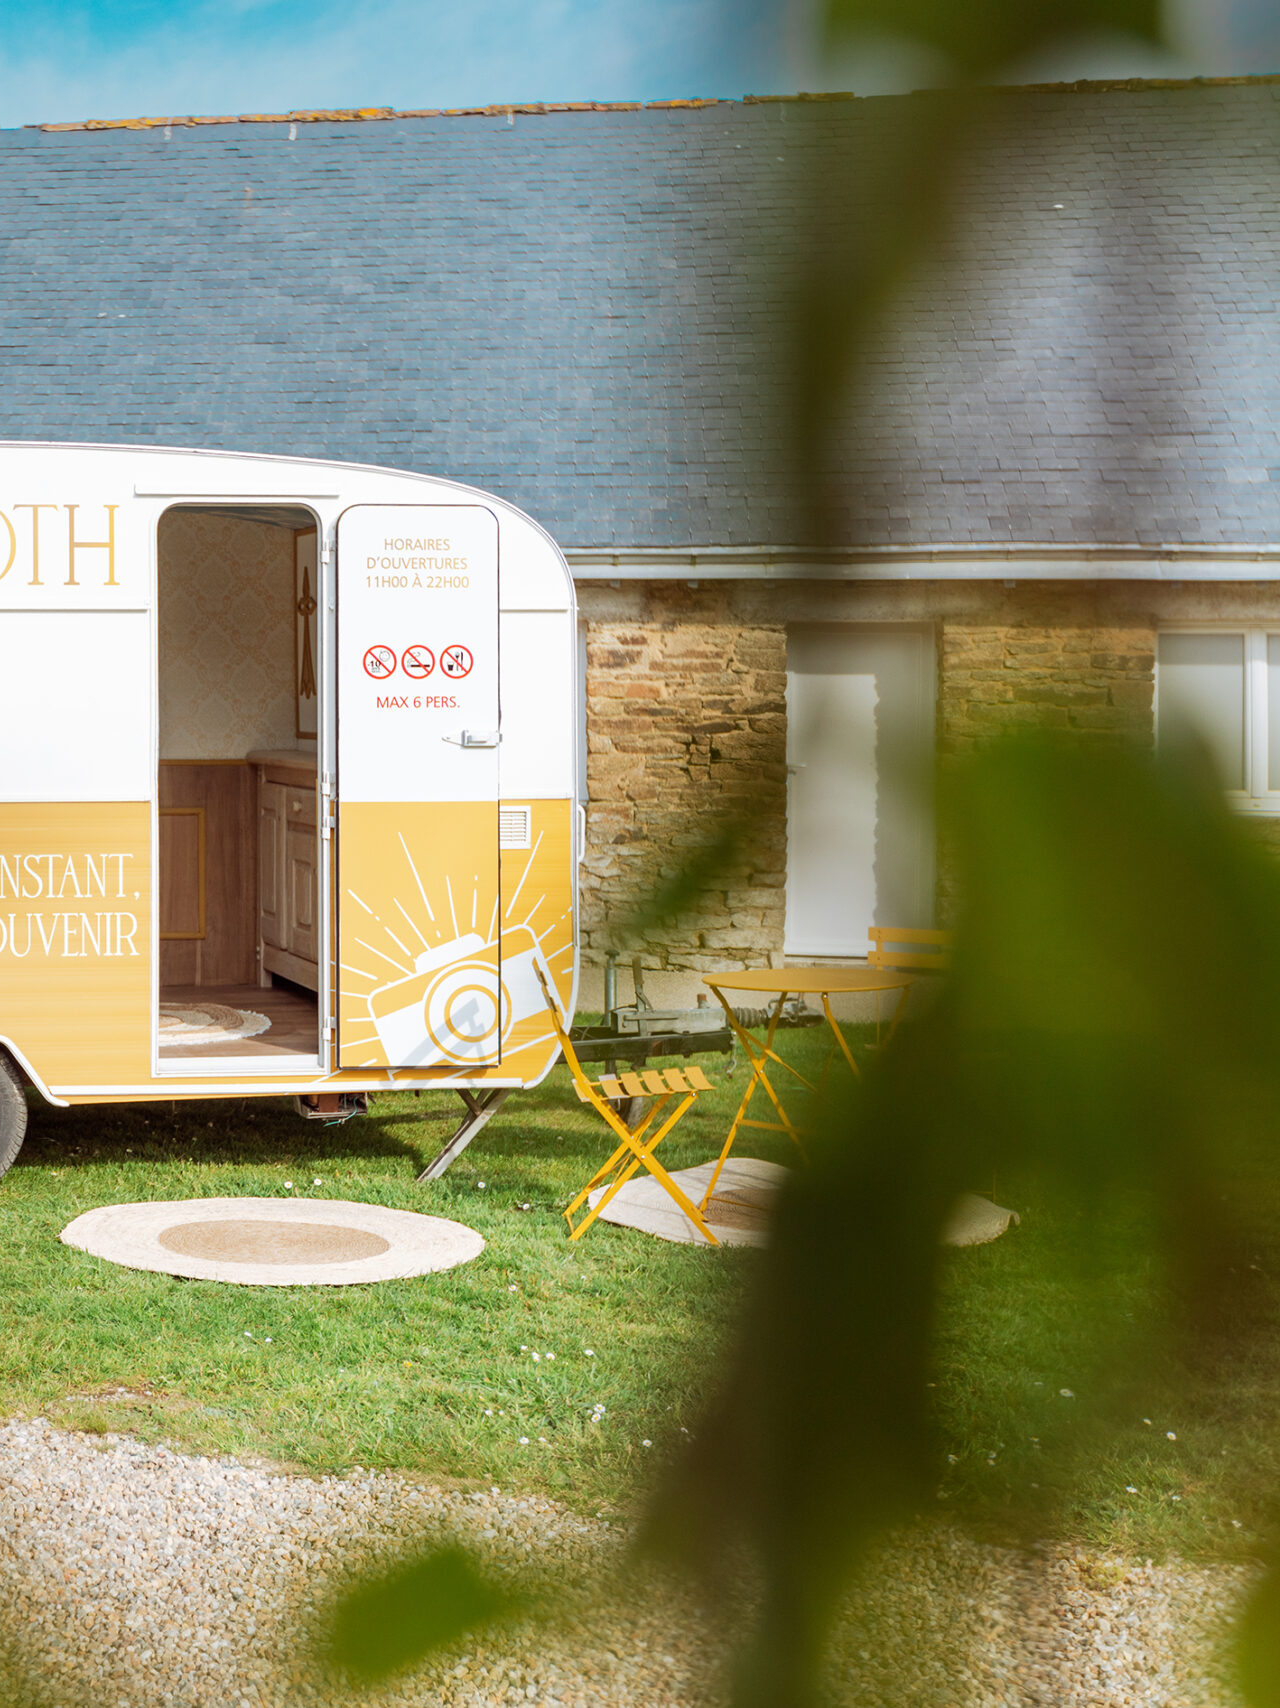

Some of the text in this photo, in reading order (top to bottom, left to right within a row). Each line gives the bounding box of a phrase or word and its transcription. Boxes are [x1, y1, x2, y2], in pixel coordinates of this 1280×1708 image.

[384, 538, 451, 551] HORAIRES
[366, 557, 468, 570] D’OUVERTURES
[365, 573, 470, 588] 11H00 À 22H00
[376, 696, 461, 708] MAX 6 PERS.
